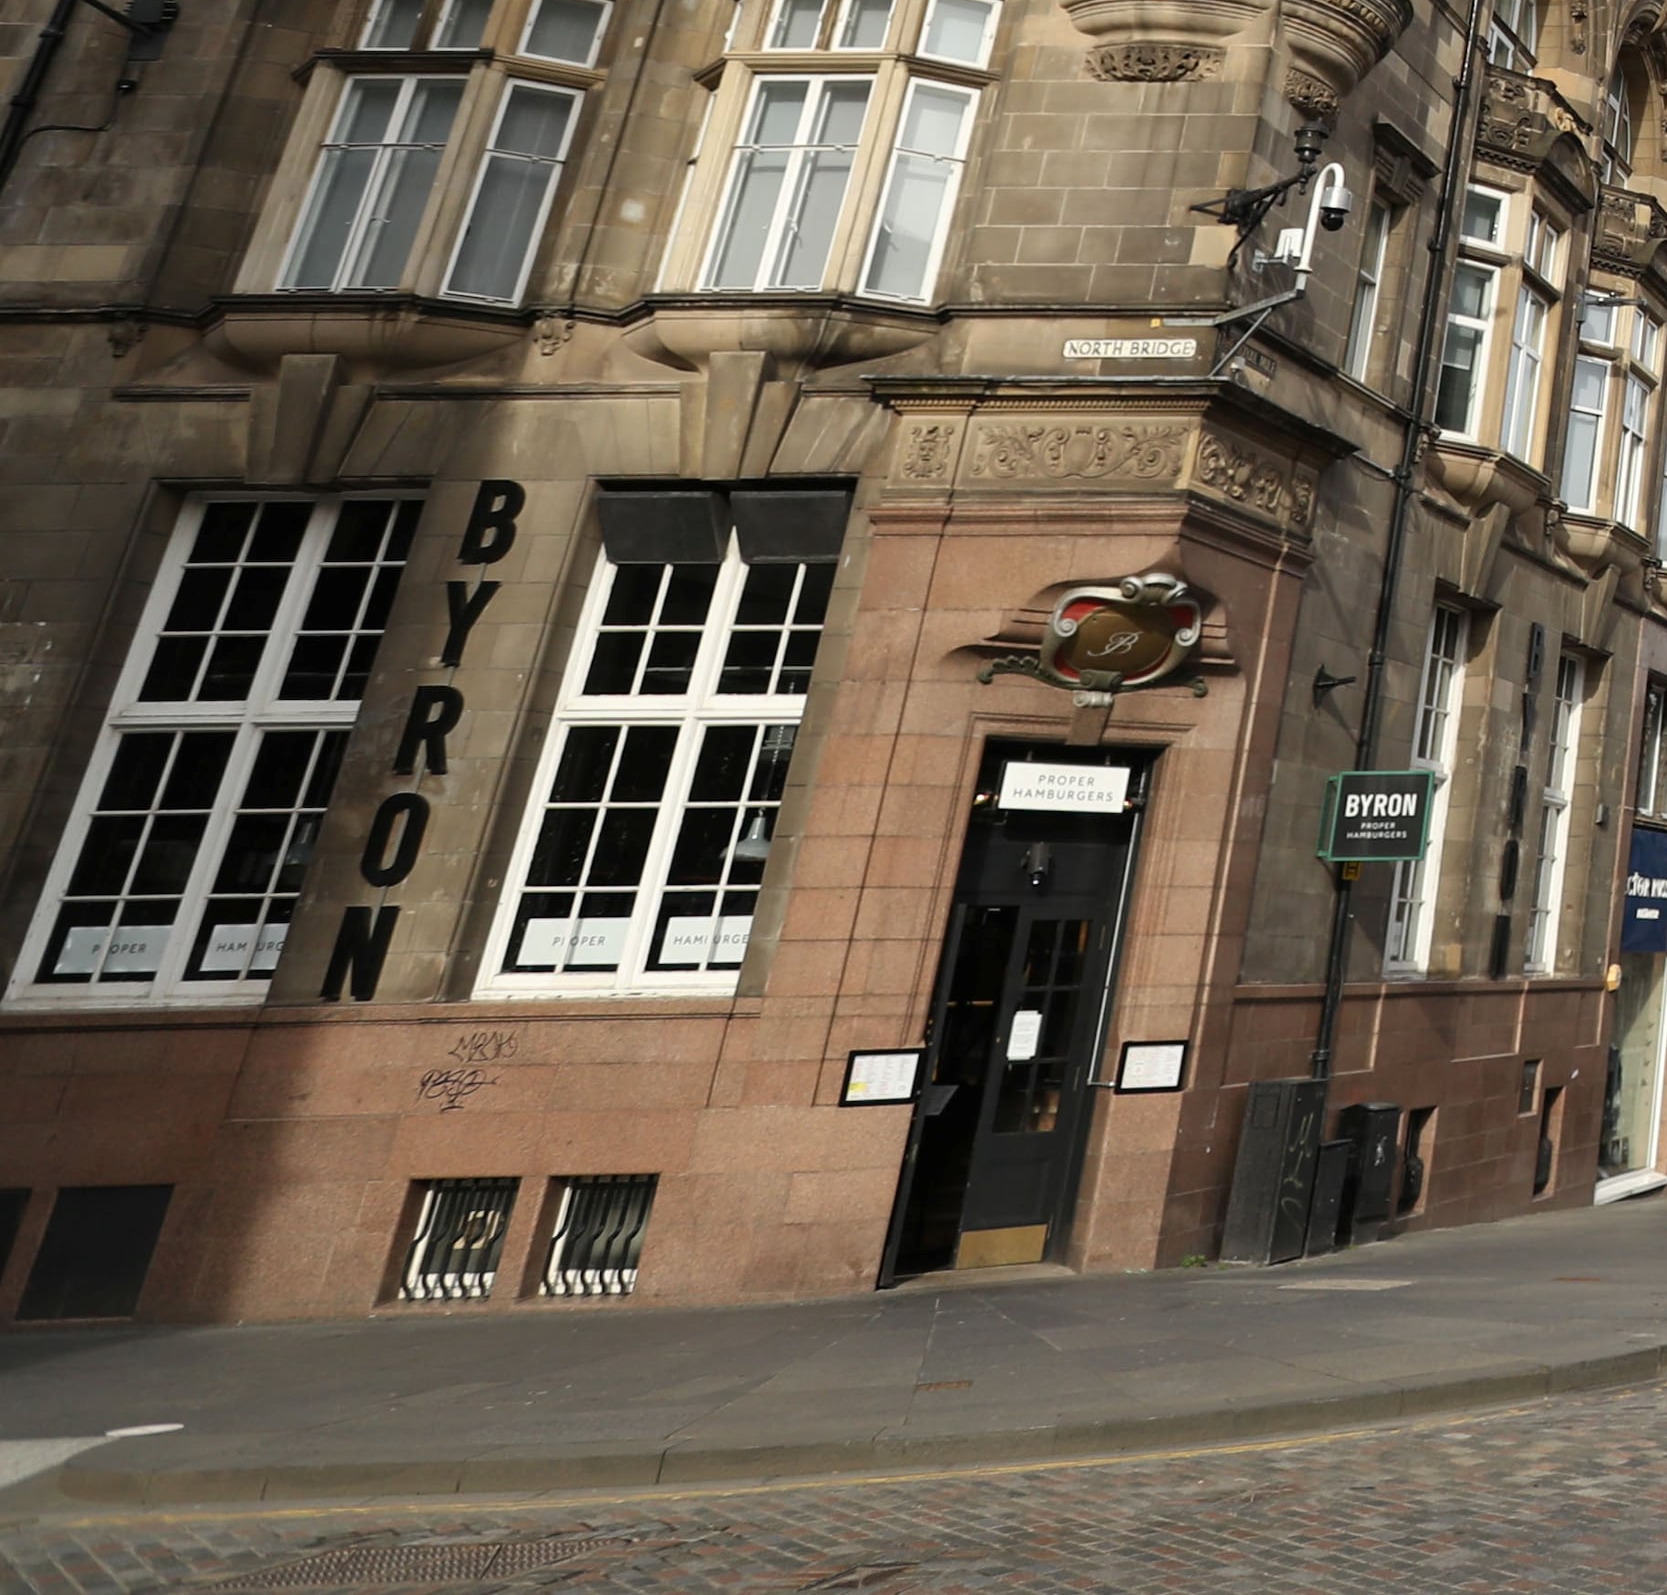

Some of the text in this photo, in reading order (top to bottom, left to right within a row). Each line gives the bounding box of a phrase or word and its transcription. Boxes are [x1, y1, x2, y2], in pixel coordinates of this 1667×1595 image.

[1067, 340, 1193, 355] NORTH BRIDGE
[321, 477, 527, 1003] BYRON
[1038, 774, 1095, 787] PROPER
[1012, 787, 1114, 802] HAMBURGERS
[1344, 793, 1418, 818] BYRON
[1360, 822, 1396, 830] PROPER
[1346, 830, 1408, 840] HAMBURGERS
[91, 942, 148, 955] POPER
